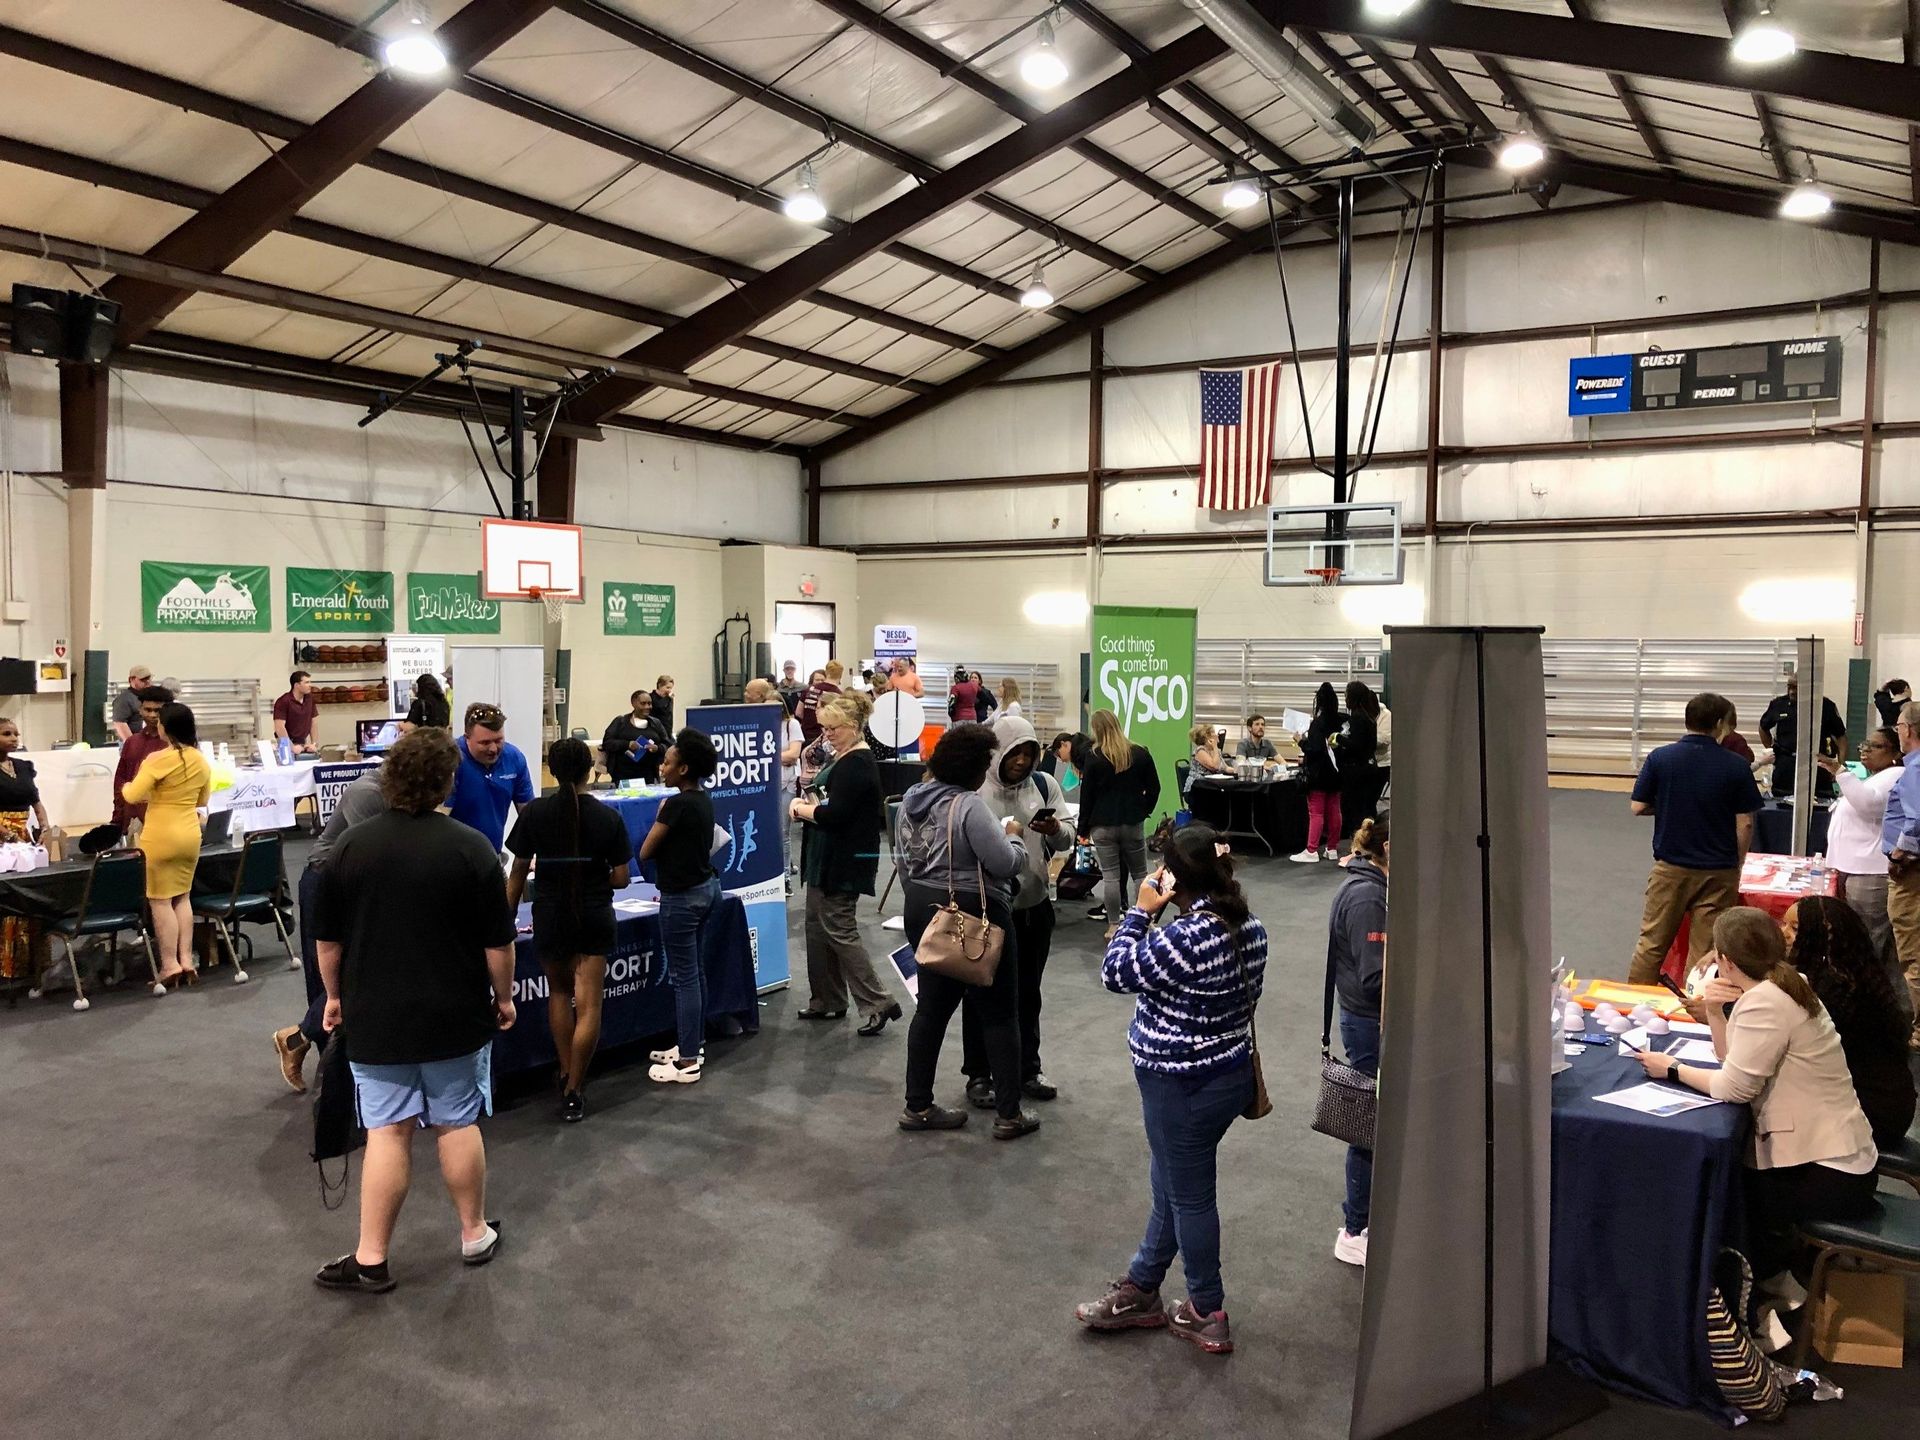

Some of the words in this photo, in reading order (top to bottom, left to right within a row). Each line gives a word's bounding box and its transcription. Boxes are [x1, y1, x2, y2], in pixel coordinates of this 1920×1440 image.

[1783, 341, 1828, 355] HOME
[1640, 353, 1685, 367] GUEST
[1694, 387, 1736, 400] PERIOD
[166, 597, 232, 608] FOOTHILLS
[292, 592, 347, 609] Emerald
[352, 594, 389, 609] Youth
[157, 608, 210, 621] PHYSICAL
[210, 609, 258, 621] THERAPY
[314, 611, 372, 621] SPORTS
[1100, 635, 1126, 653] Good
[1127, 635, 1155, 657] things
[1122, 658, 1147, 672] come
[1148, 653, 1168, 672] from
[1100, 659, 1188, 740] Sysco
[710, 731, 758, 758] PINE
[762, 729, 777, 755] &
[321, 770, 332, 779] WE
[333, 769, 360, 778] PROUDLY
[710, 788, 739, 799] PHYSICAL
[740, 785, 767, 795] THERAPY
[604, 950, 654, 982] ORT
[603, 977, 648, 1000] THERAPY
